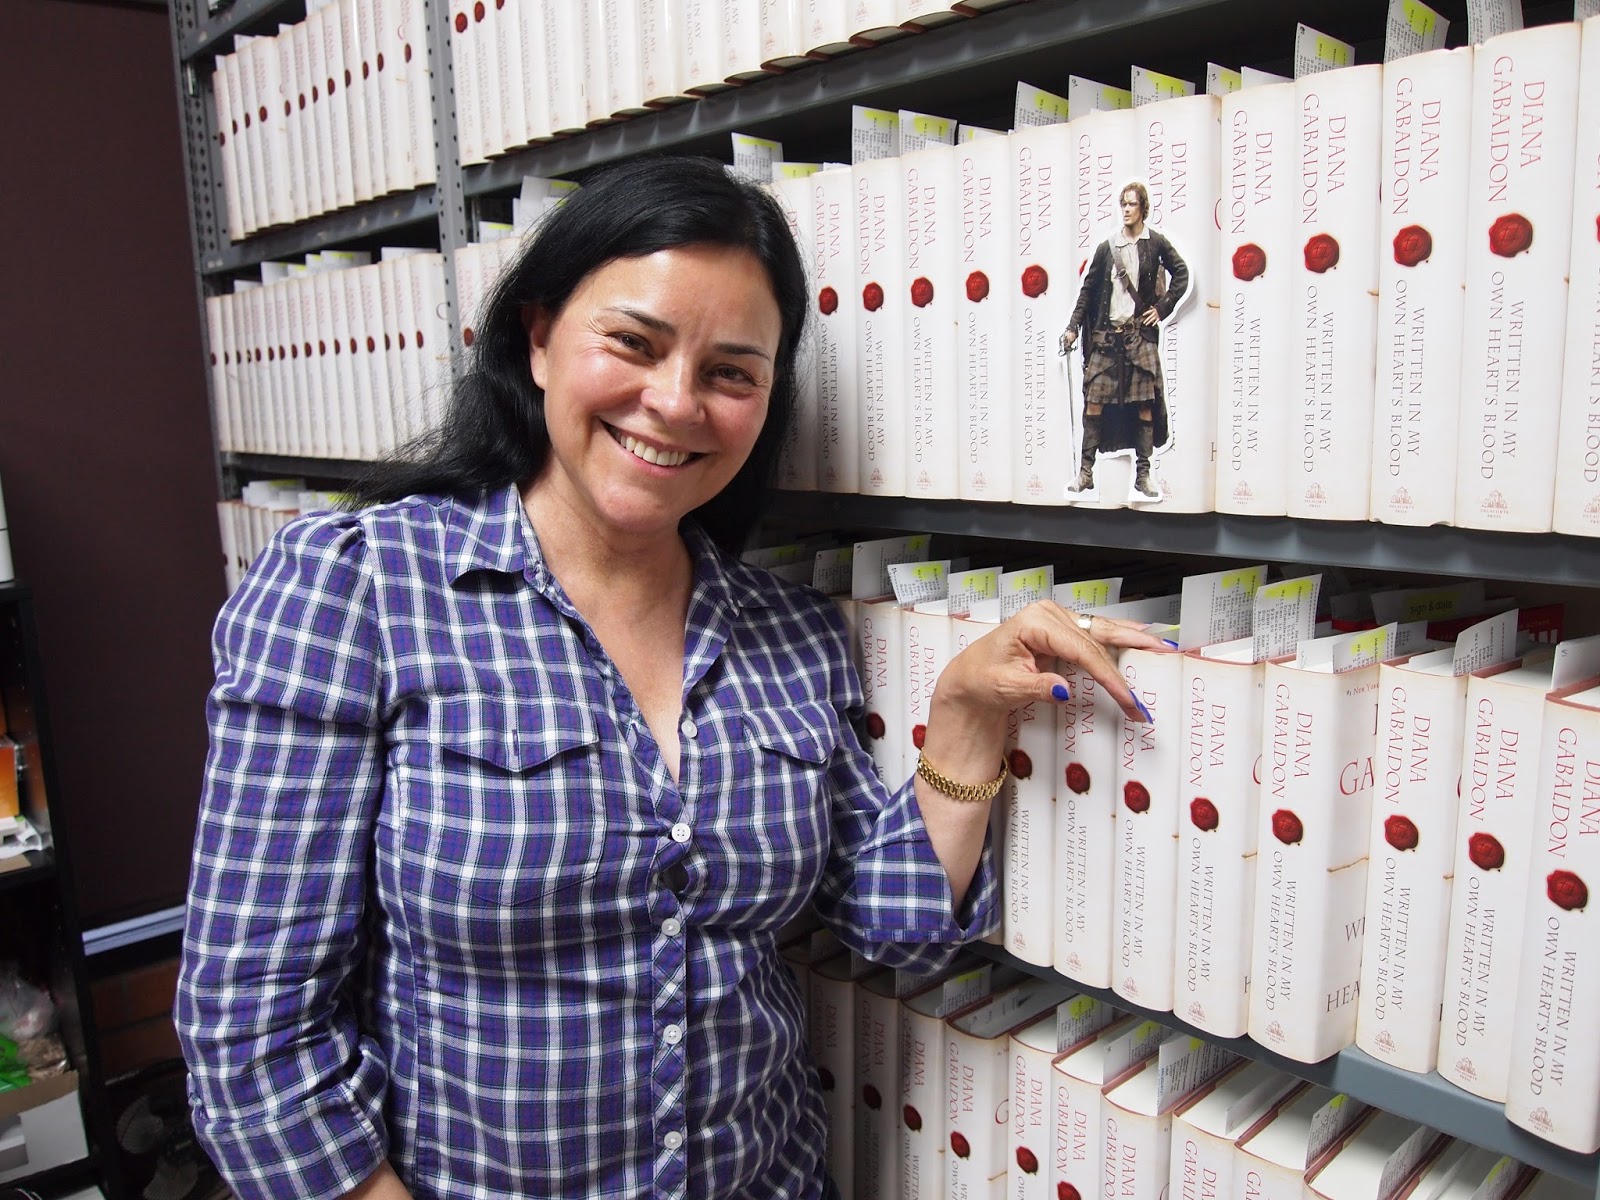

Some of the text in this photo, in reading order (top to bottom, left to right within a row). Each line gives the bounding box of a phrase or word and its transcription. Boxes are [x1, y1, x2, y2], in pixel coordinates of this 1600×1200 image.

[1255, 131, 1272, 205] DIANA
[1303, 93, 1319, 224] GABALDON
[1328, 114, 1346, 193] DIANA
[1392, 78, 1412, 215] GABALDON
[1420, 99, 1441, 182] DIANA
[1488, 56, 1514, 202] GABALDON
[1520, 80, 1545, 168] DIANA
[924, 186, 936, 246] DIANA
[962, 158, 974, 263] GABALDON
[979, 176, 992, 238] DIANA
[1020, 147, 1031, 256] GABALDON
[1038, 166, 1051, 231] DIANA
[1079, 134, 1090, 248] GABALDON
[1098, 154, 1112, 222] DIANA
[1171, 142, 1187, 213] DIANA
[1232, 110, 1248, 234] GABALDON
[816, 186, 825, 279] GABALDON
[830, 204, 839, 258] DIANA
[859, 178, 870, 275] GABALDON
[874, 196, 885, 252] DIANA
[908, 168, 919, 269] GABALDON
[1024, 308, 1033, 345] OWN
[1167, 322, 1177, 399] WRITTEN
[925, 408, 932, 421] IN
[979, 334, 988, 447] WRITTEN IN MY
[1037, 330, 1045, 449] WRITTEN IN MY
[1232, 292, 1245, 471] OWN HEART'S BLOOD
[1248, 318, 1260, 452] WRITTEN IN MY
[1304, 286, 1317, 473] OWN HEART'S BLOOD
[1320, 312, 1333, 453] WRITTEN IN MY
[1390, 280, 1407, 477] OWN HEART'S BLOOD
[1408, 308, 1424, 455] WRITTEN IN MY
[1480, 271, 1504, 479] OWN HEART'S BLOOD
[1502, 301, 1524, 458] WRITTEN IN MY
[926, 428, 933, 447] MY
[1583, 414, 1600, 483] BLOOD
[864, 618, 872, 704] GABALDON
[876, 639, 887, 688] DIANA
[910, 626, 920, 716] GABALDON
[924, 647, 935, 698] DIANA
[1082, 677, 1094, 734] DIANA
[1124, 666, 1138, 771] GALDON
[1141, 691, 1156, 752] DINA
[1190, 677, 1205, 787] GABALDON
[1210, 704, 1226, 767] DIANA
[1272, 684, 1290, 798] GABALDON
[1294, 713, 1312, 777] DIANA
[1385, 687, 1406, 804] GABALDON
[1410, 716, 1431, 782] DIANA
[1469, 698, 1493, 821] GABALDON
[1496, 728, 1519, 799] DIANA
[1067, 800, 1075, 835] OWN
[1125, 820, 1133, 855] OWN
[1547, 728, 1577, 858] GABALDON
[1579, 760, 1600, 835] DIANA
[1077, 826, 1086, 933] WRITTEN IN MY
[1133, 846, 1145, 957] WRITTEN IN MY
[1188, 838, 1200, 992] OWN HEART'S BLOOD
[1200, 866, 1214, 981] WRITTEN IN MY
[1266, 851, 1283, 1011] OWN HEART'S BLOOD
[1281, 880, 1297, 1000] WRITTEN IN MY
[1376, 858, 1396, 1020] OWN HEART'S BLOOD
[1391, 887, 1410, 1010] WRITTEN IN MY
[1456, 876, 1479, 1046] OWN HEART'S BLOOD
[1473, 909, 1495, 1036] WRITTEN IN MY
[1530, 916, 1560, 1096] OWN HEART'S BLOOD
[1550, 951, 1577, 1086] WRITTEN IN MY
[904, 1018, 913, 1100] GABALDON
[915, 1041, 925, 1086] DIANA
[950, 1042, 959, 1125] GABALDON
[963, 1066, 974, 1112] DIANA
[1016, 1055, 1026, 1139] GABALDON
[1031, 1078, 1042, 1127] DIANA
[1057, 1086, 1069, 1174] GABALDON
[1073, 1110, 1086, 1161] DIANA
[1105, 1118, 1118, 1200] GABALDO
[1122, 1144, 1136, 1196] DIANA
